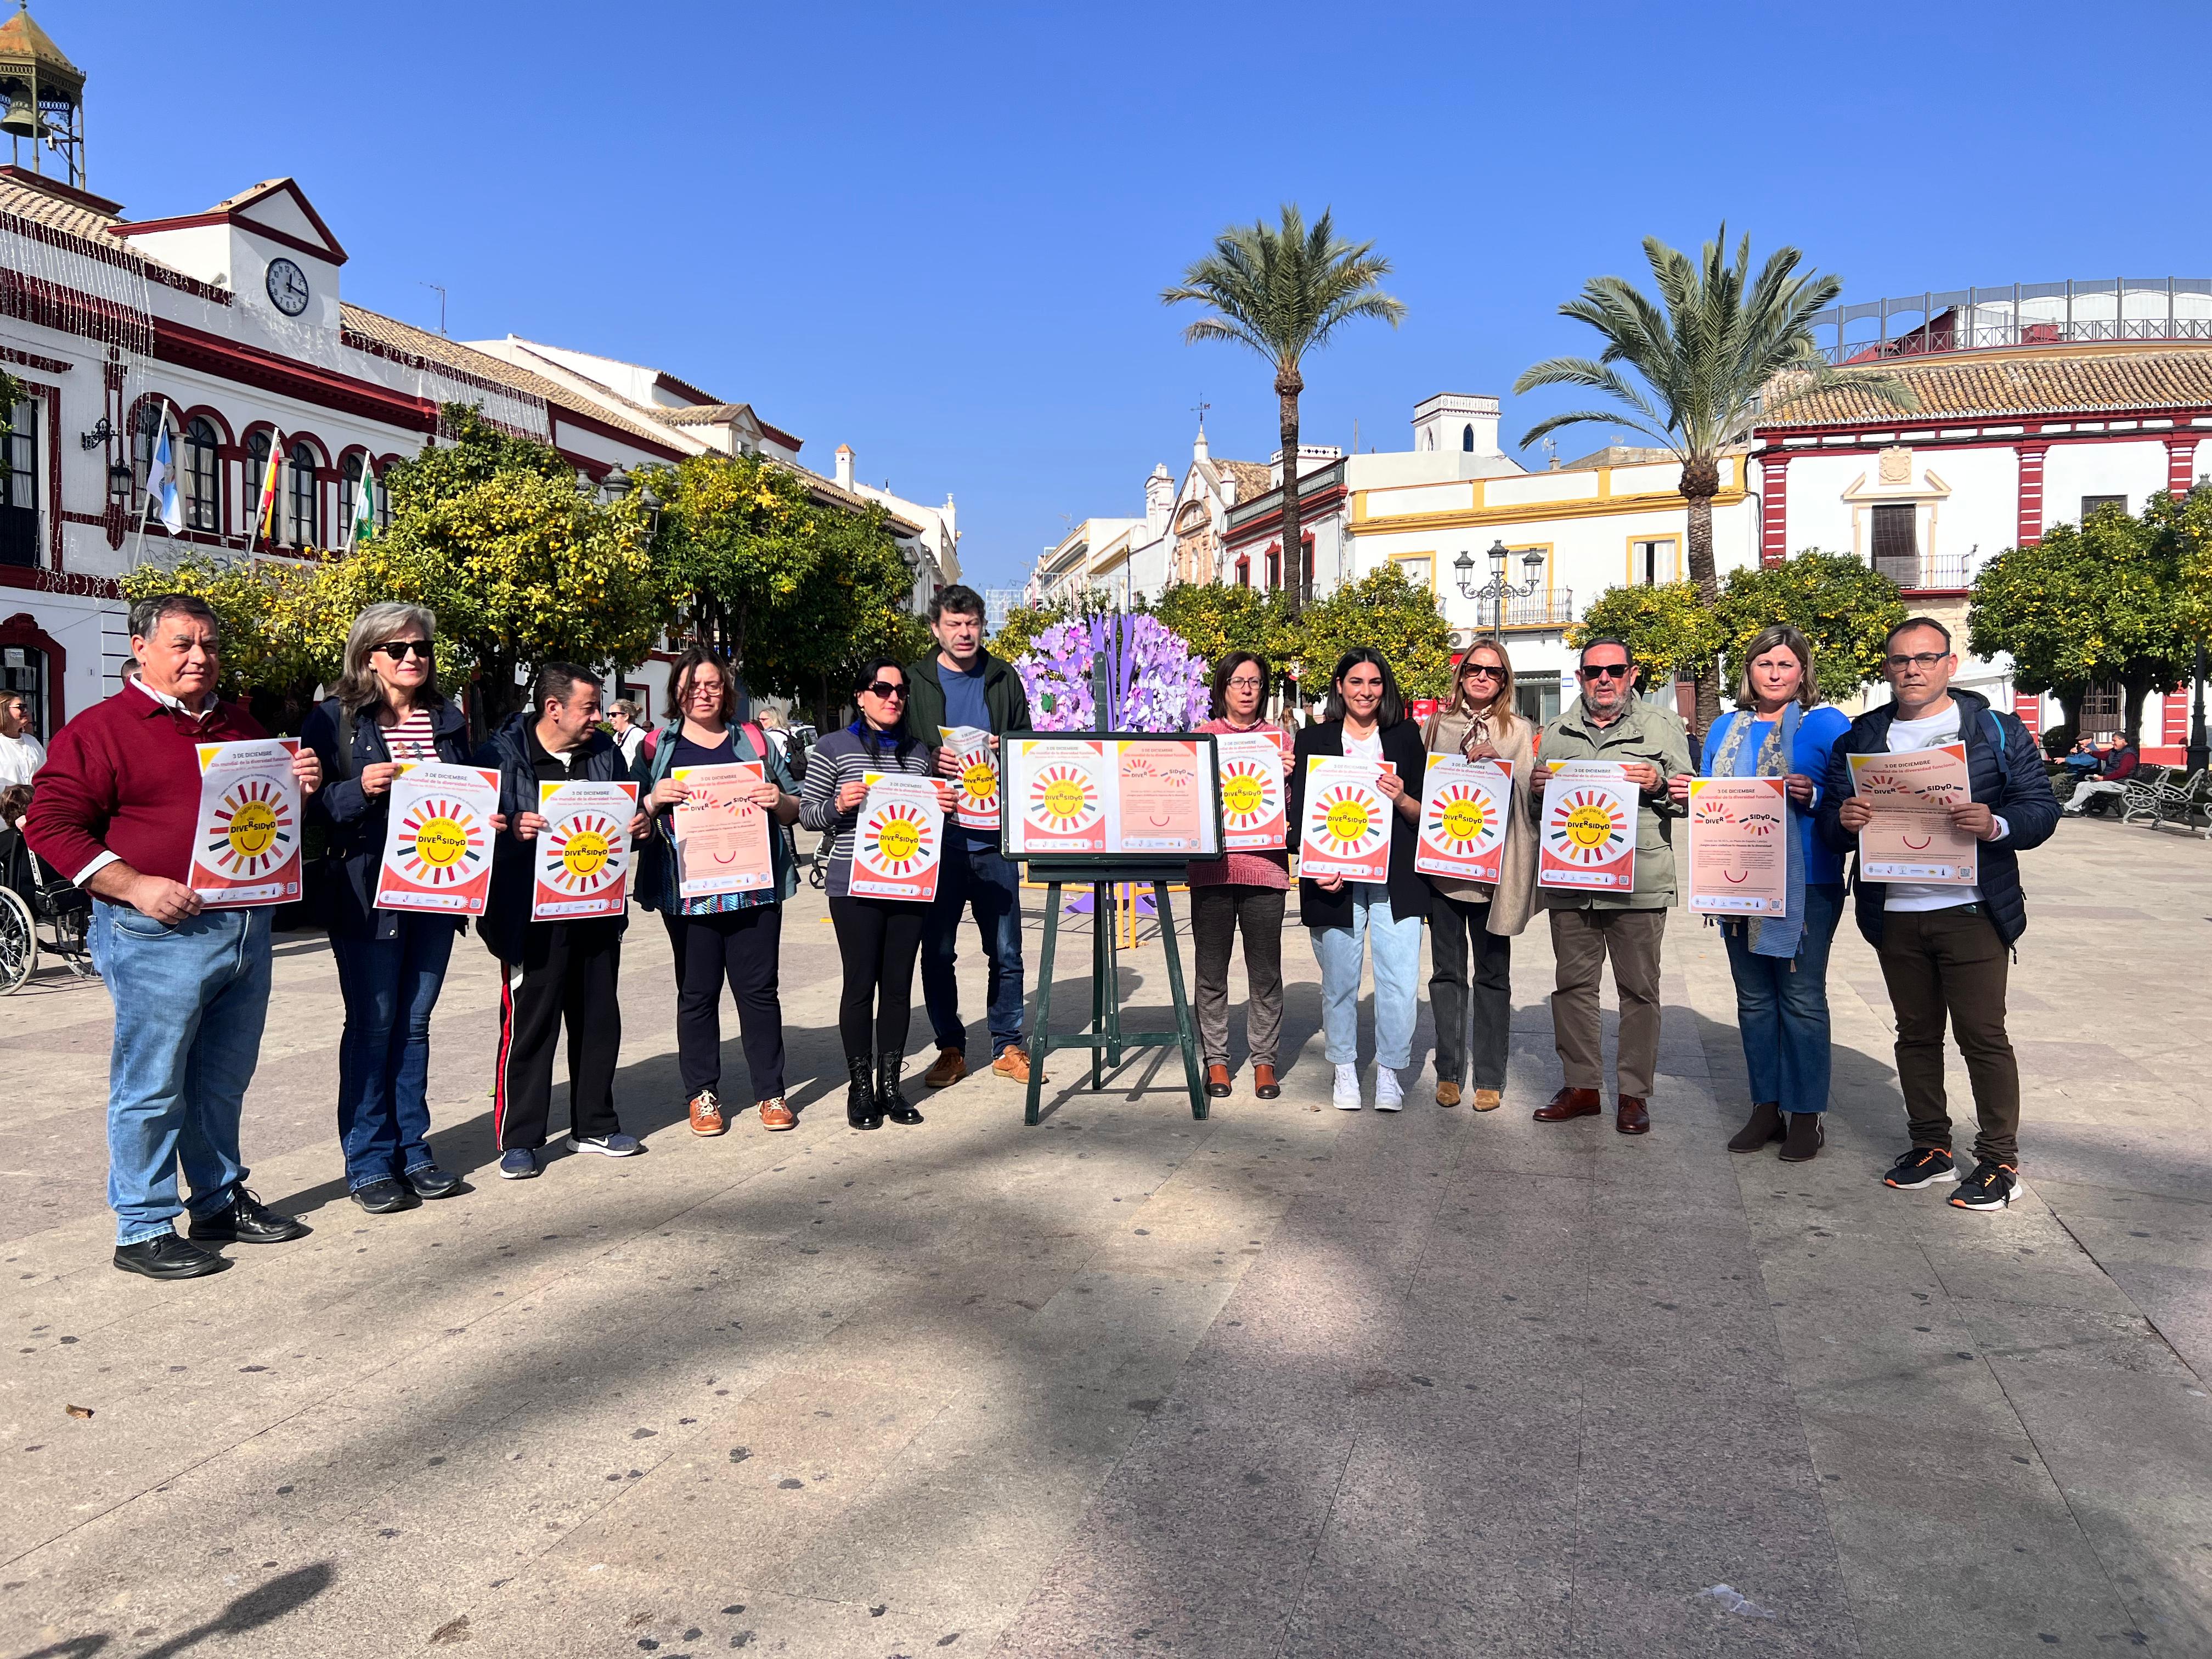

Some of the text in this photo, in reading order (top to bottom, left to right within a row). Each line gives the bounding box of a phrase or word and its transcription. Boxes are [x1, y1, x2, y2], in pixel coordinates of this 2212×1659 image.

[1898, 759, 1931, 768] DICIEMBRE
[691, 803, 709, 811] DIVER
[1328, 815, 1367, 824] DIVERSIDAD
[1443, 814, 1482, 824] DIVERSIDAD
[231, 821, 275, 833] DIVERSIDAD
[427, 821, 441, 830] jugar
[442, 821, 455, 829] para
[1568, 821, 1609, 830] DIVERSIDAD
[418, 834, 466, 847] DIVERSIDAD
[573, 834, 586, 844] jugar
[880, 834, 918, 844] DIVERSIDAD
[565, 847, 607, 856] DIVERSIDAD
